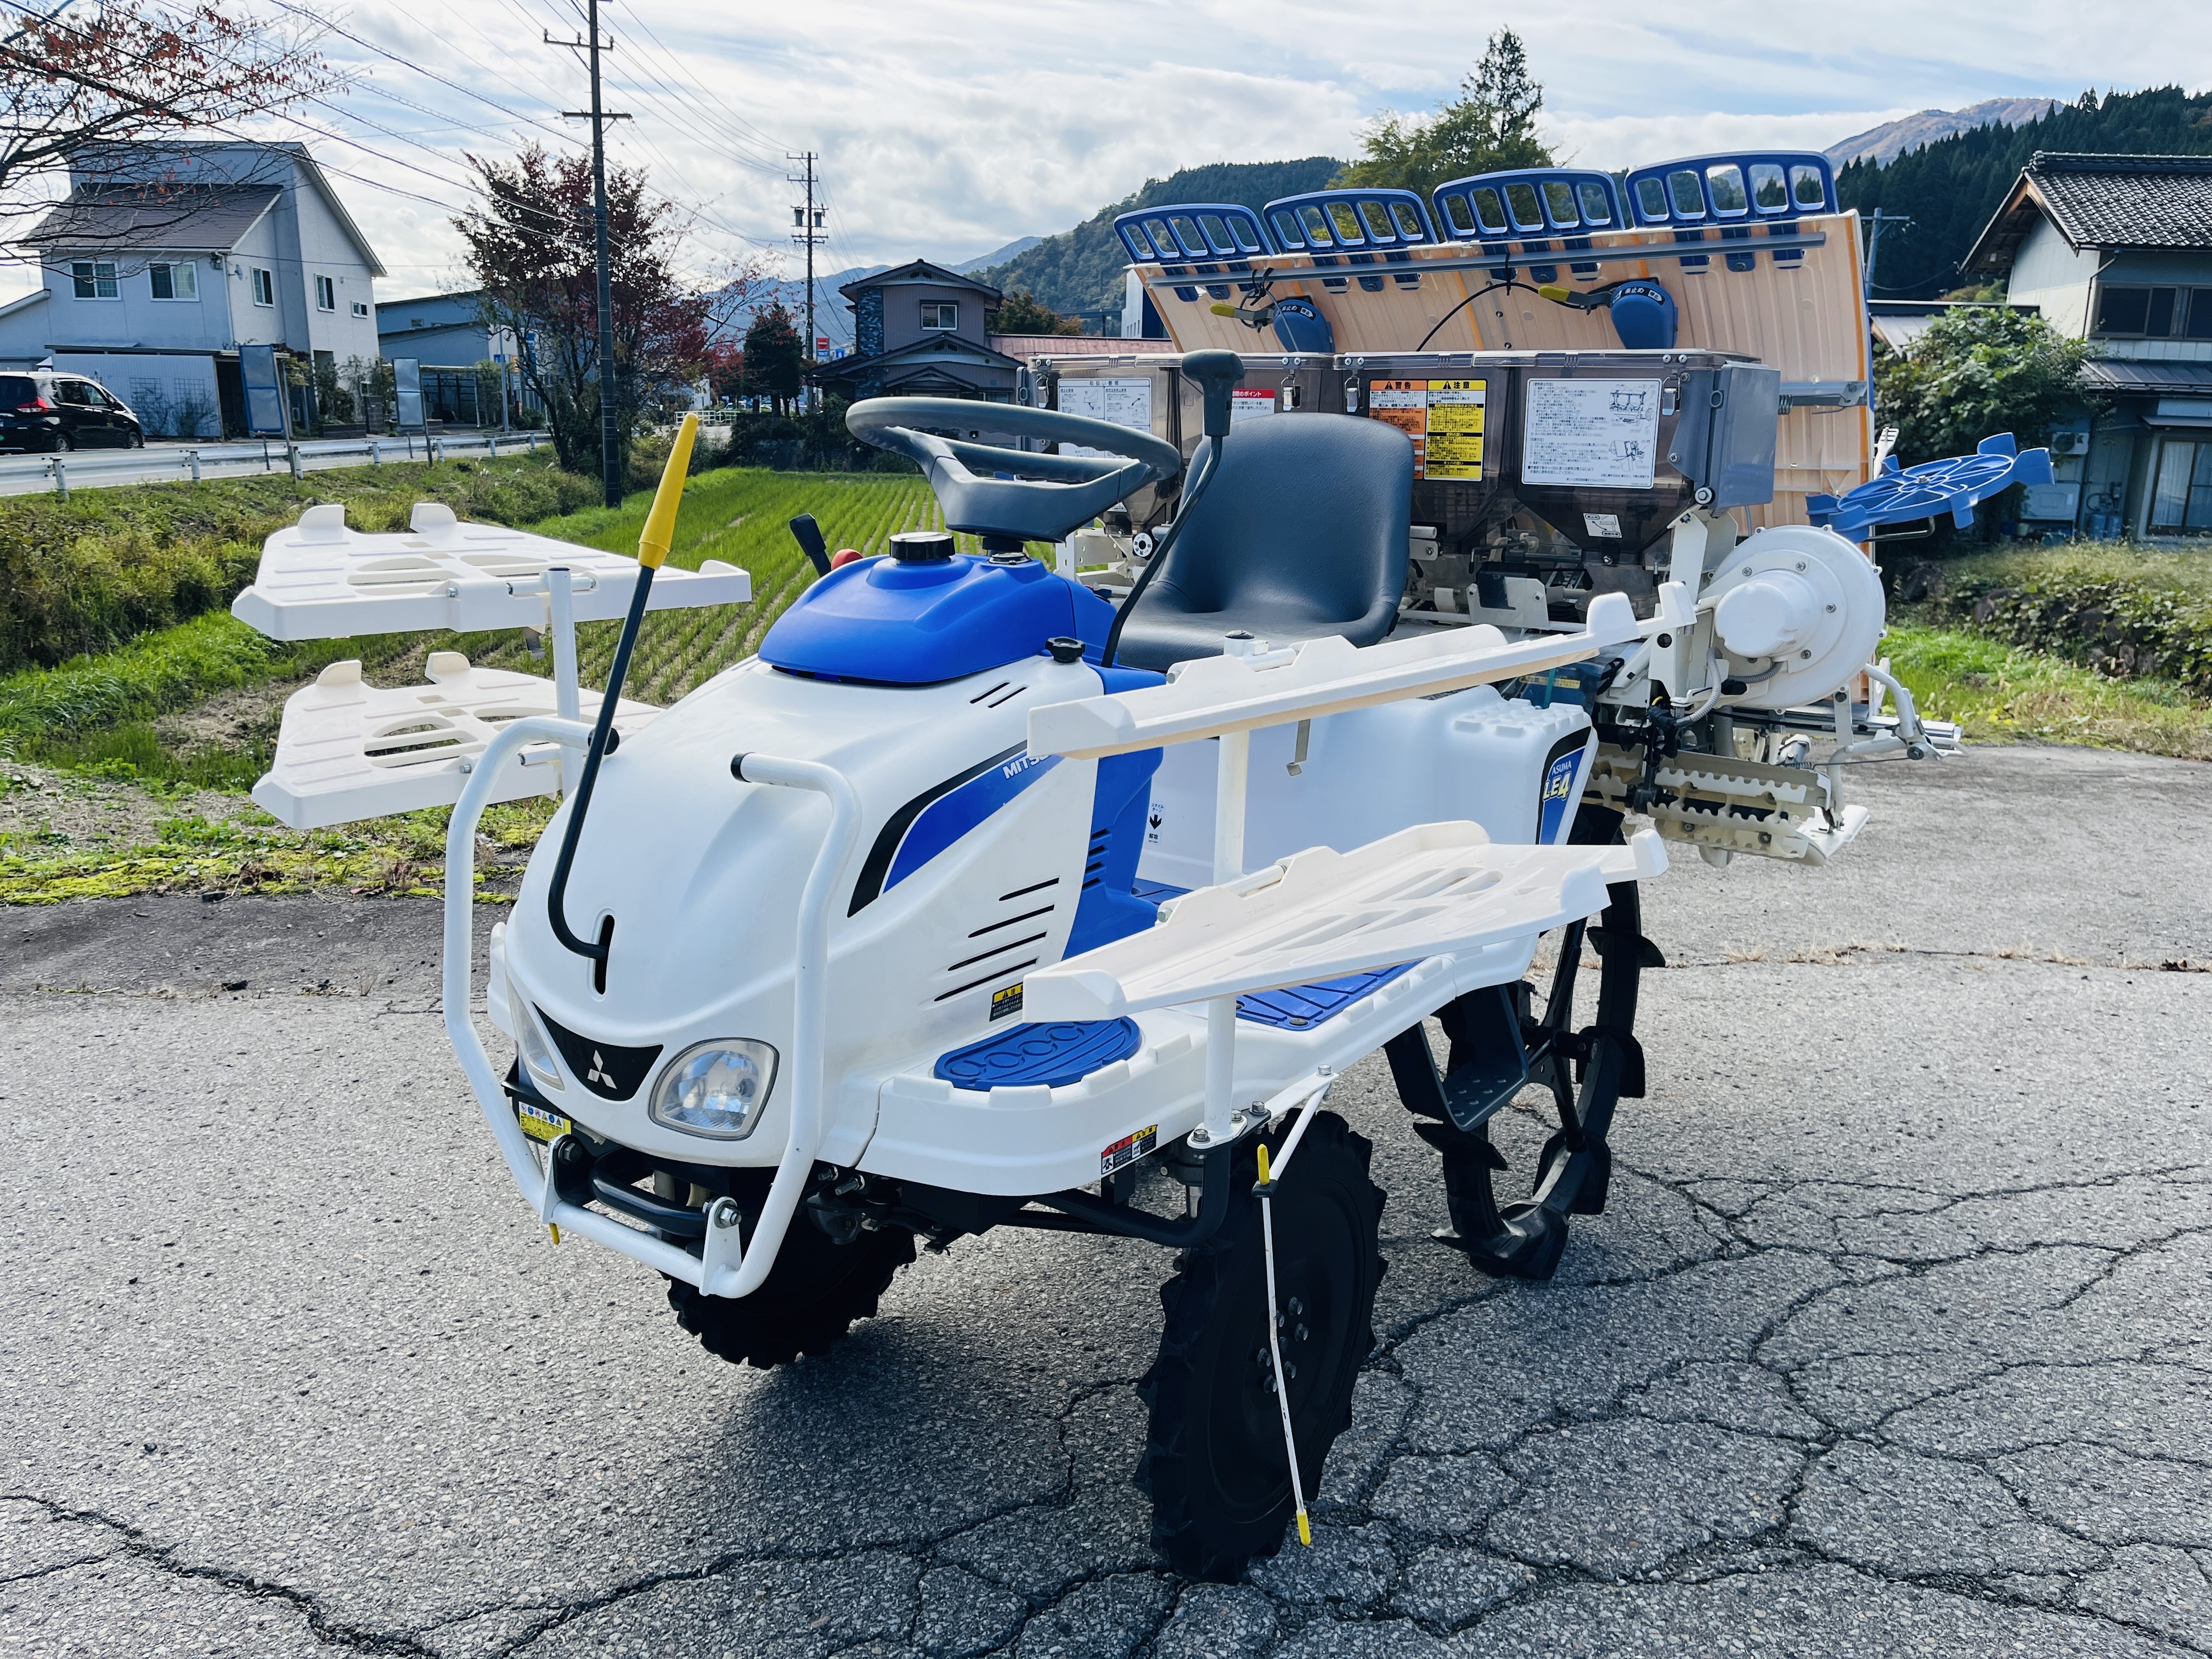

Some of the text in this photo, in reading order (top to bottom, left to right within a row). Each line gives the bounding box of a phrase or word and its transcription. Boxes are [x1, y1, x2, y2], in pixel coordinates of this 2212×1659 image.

[1395, 381, 1411, 390] 警告
[1551, 760, 1572, 776] ASUMA
[1542, 771, 1572, 802] LE4
